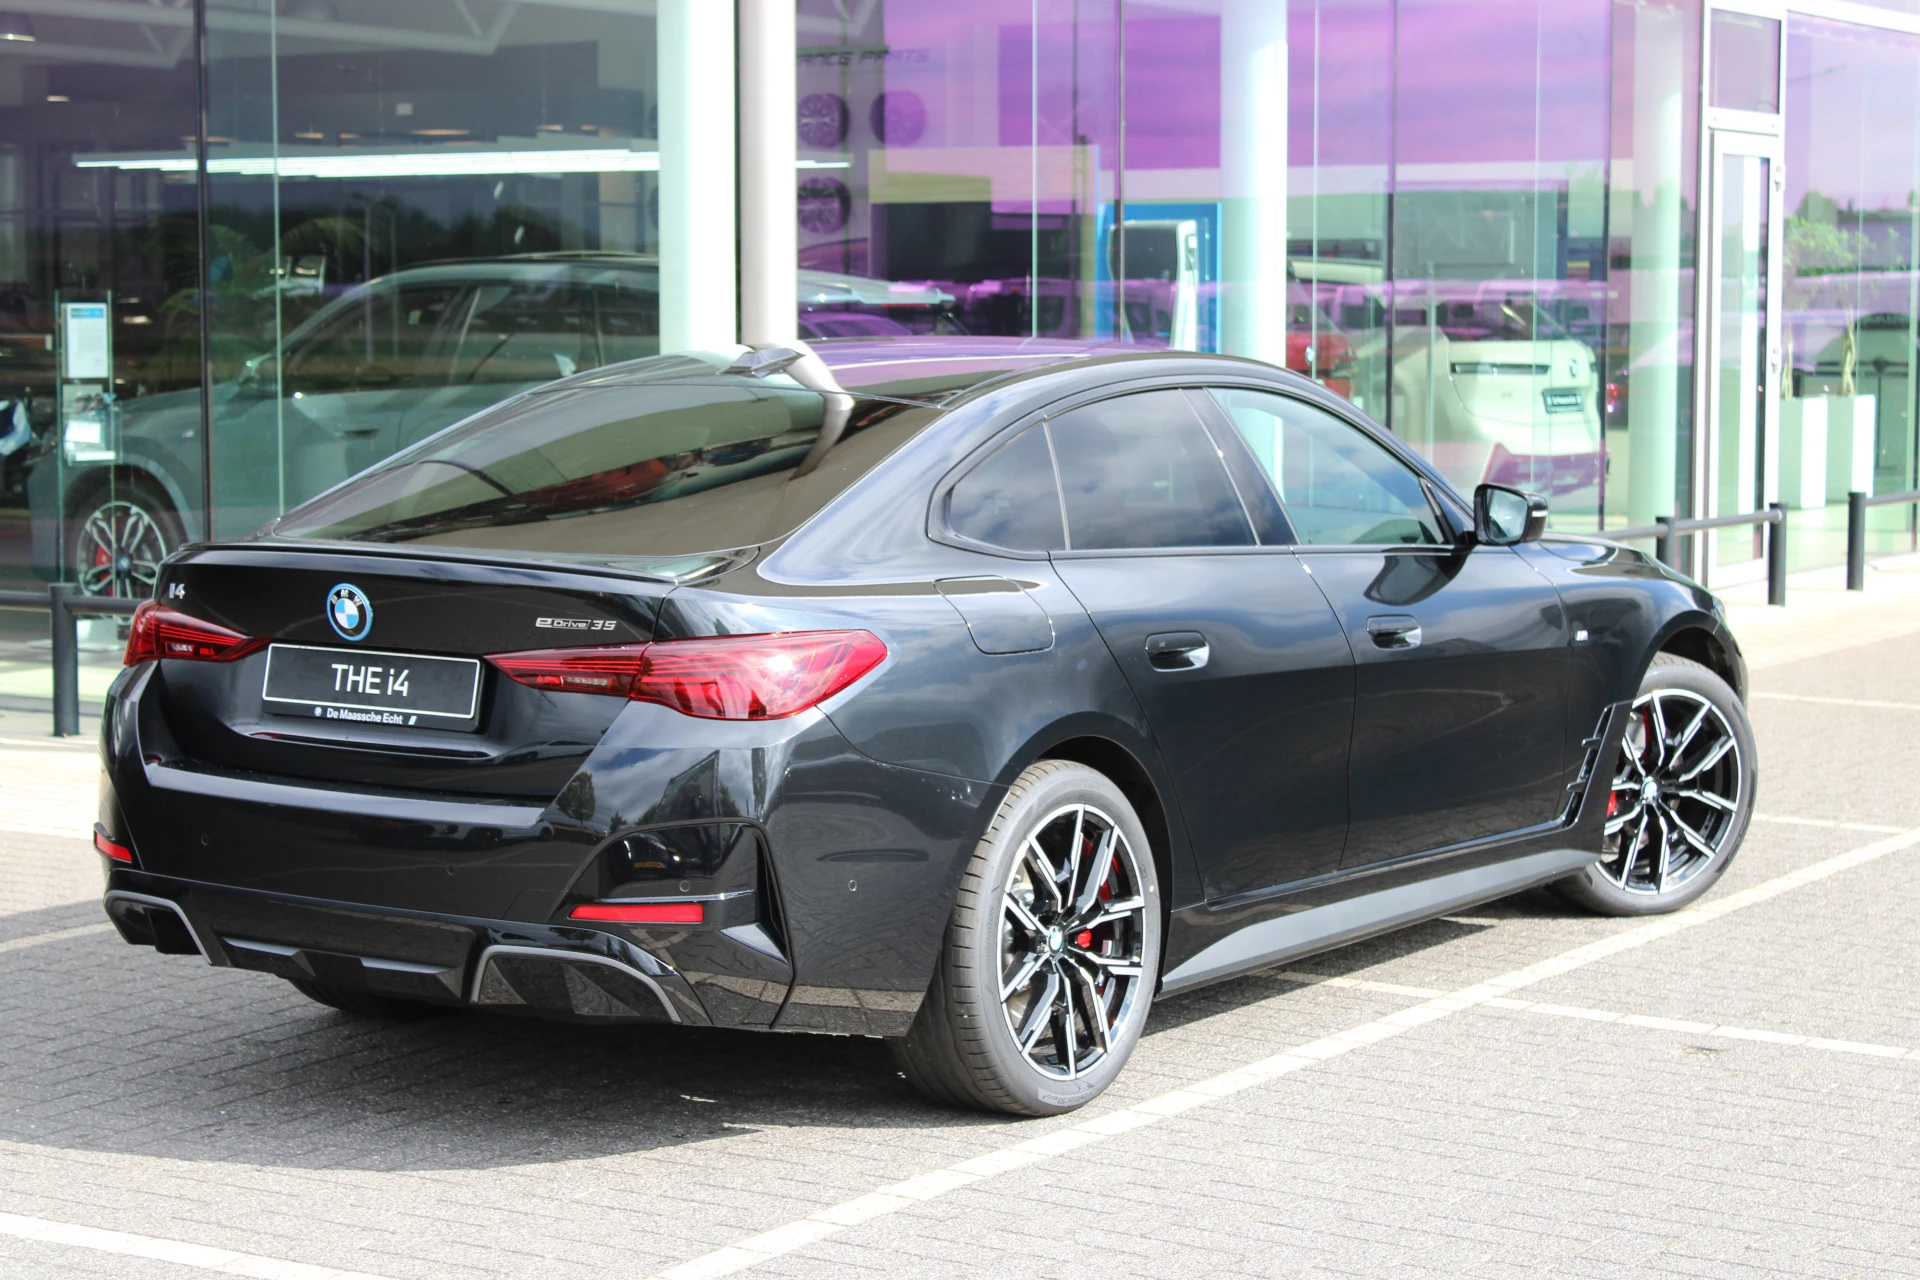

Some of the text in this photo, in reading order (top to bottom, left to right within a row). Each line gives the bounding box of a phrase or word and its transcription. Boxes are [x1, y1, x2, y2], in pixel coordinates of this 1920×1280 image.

[590, 620, 617, 631] 35
[331, 663, 410, 697] THE i4
[326, 707, 403, 725] De Maassche Echt
